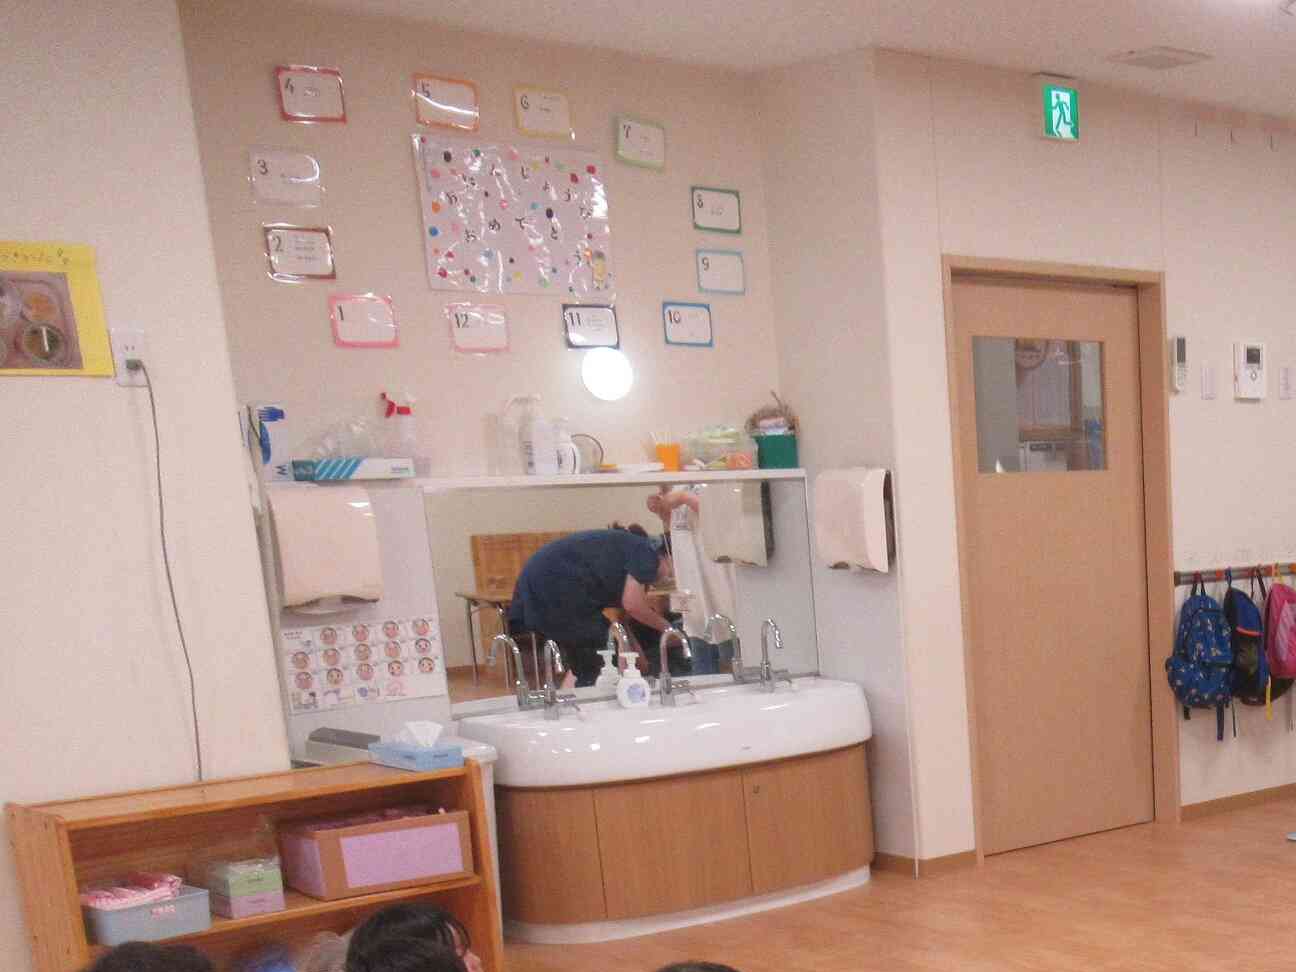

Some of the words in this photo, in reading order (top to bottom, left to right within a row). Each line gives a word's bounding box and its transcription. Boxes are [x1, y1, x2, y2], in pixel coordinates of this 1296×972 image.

[285, 77, 294, 94] 4
[257, 159, 268, 175] 3
[272, 235, 284, 253] 2
[702, 256, 710, 272] 9
[454, 312, 469, 328] 12
[569, 311, 582, 326] 11
[668, 309, 681, 324] 10
